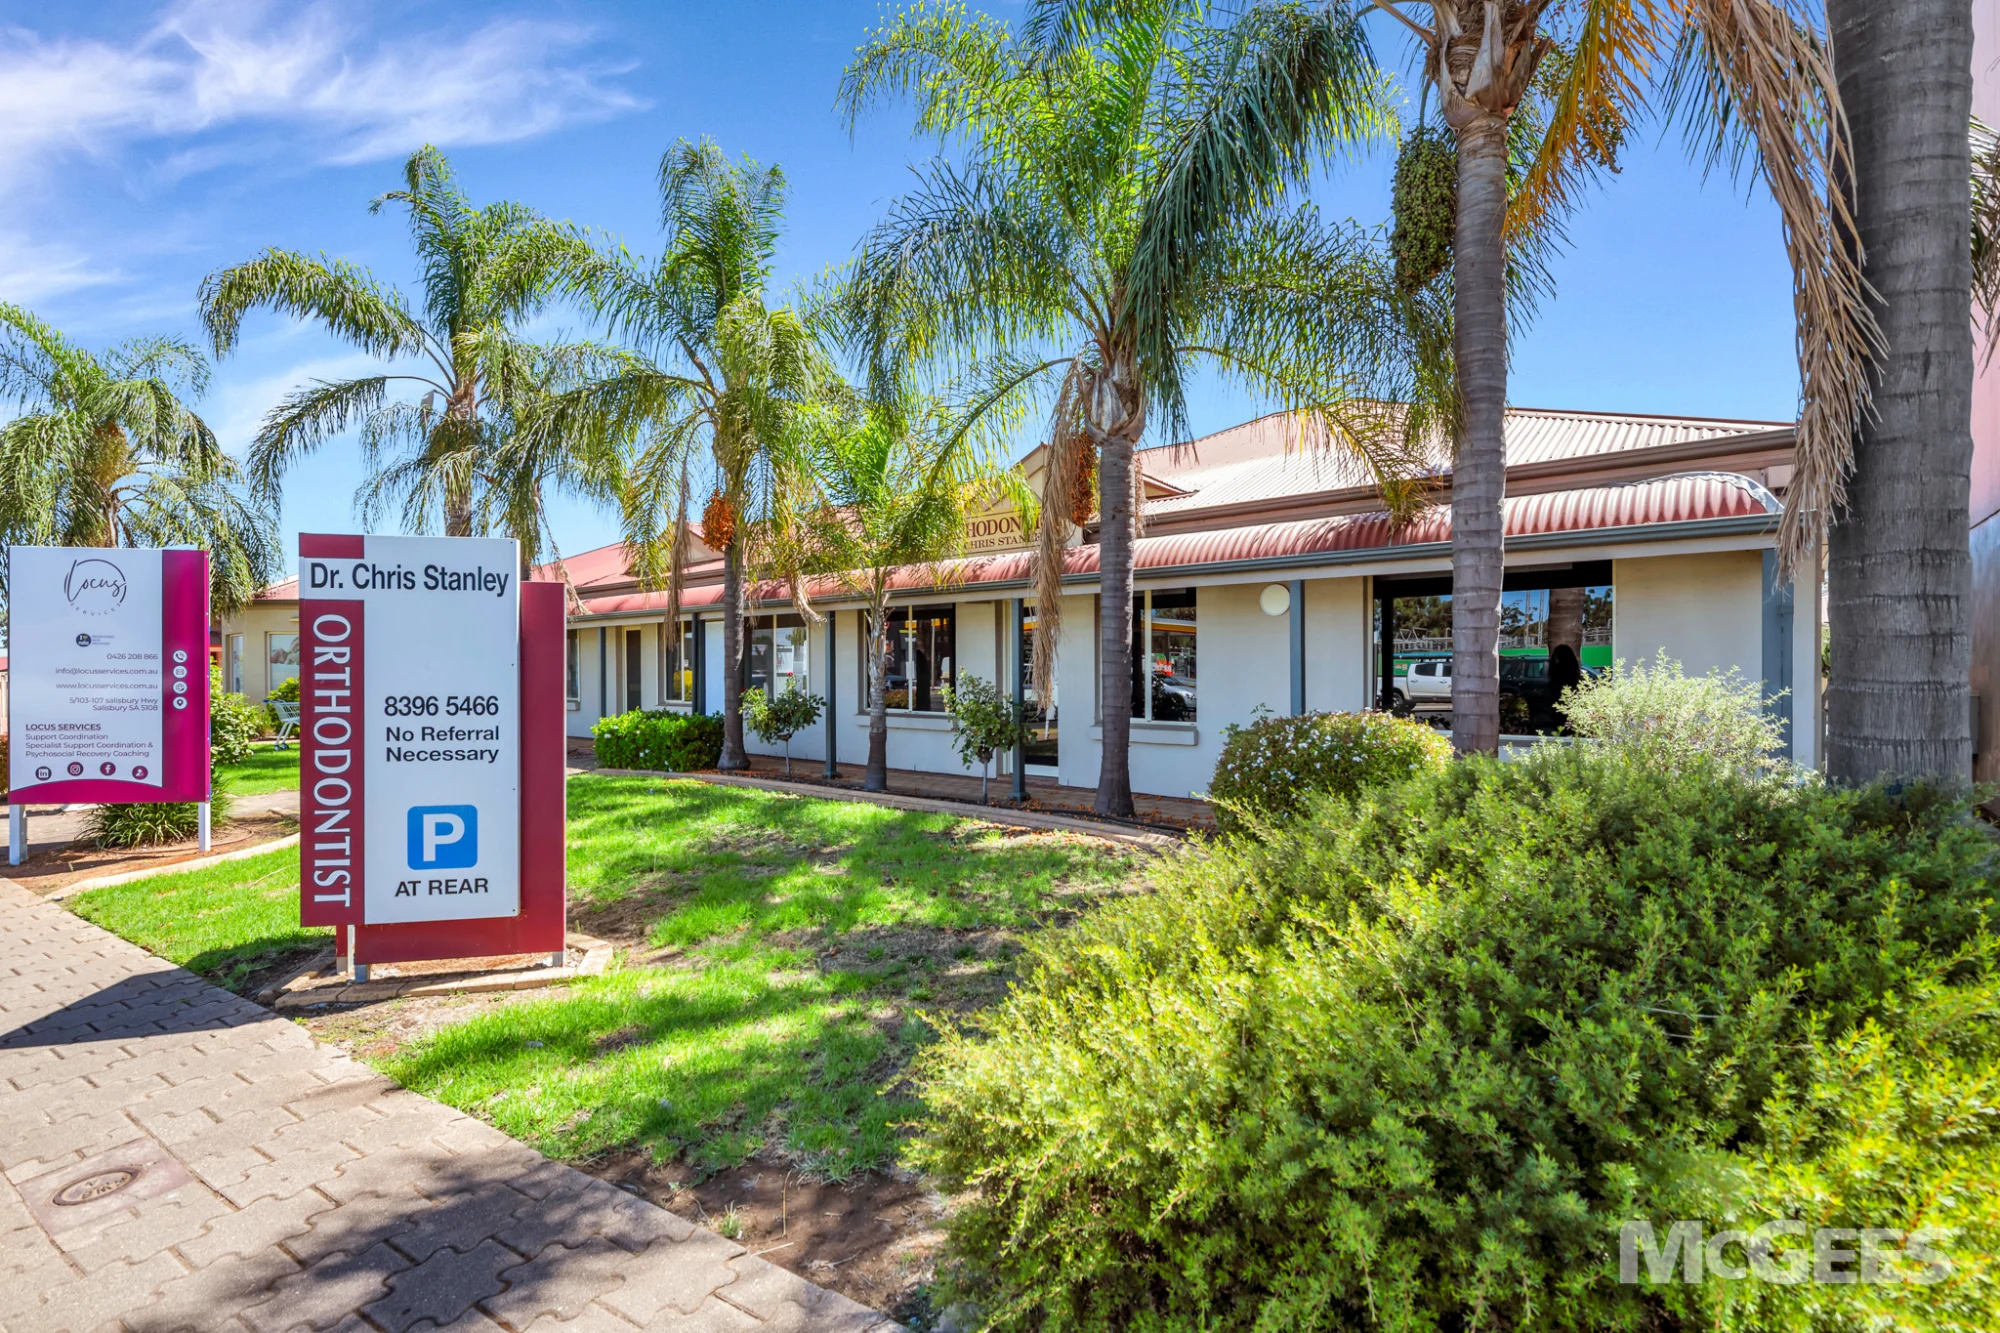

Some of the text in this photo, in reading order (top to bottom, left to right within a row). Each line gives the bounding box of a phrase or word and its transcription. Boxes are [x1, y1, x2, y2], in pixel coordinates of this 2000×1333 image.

[310, 562, 509, 597] Dr. Chris Stanley
[92, 704, 127, 712] Salisbury
[384, 695, 499, 717] 8396 5466
[25, 723, 101, 731] LOCUS SERVICES
[386, 725, 499, 742] No Referral
[25, 733, 57, 741] Support
[25, 742, 62, 750] Specialist
[63, 742, 94, 750] Support
[25, 750, 149, 758] Psychosocial Recovery Coaching
[313, 613, 352, 908] ORTHODONTIST
[386, 747, 499, 763] Necessary
[423, 813, 465, 862] P
[394, 877, 489, 897] AT REAR
